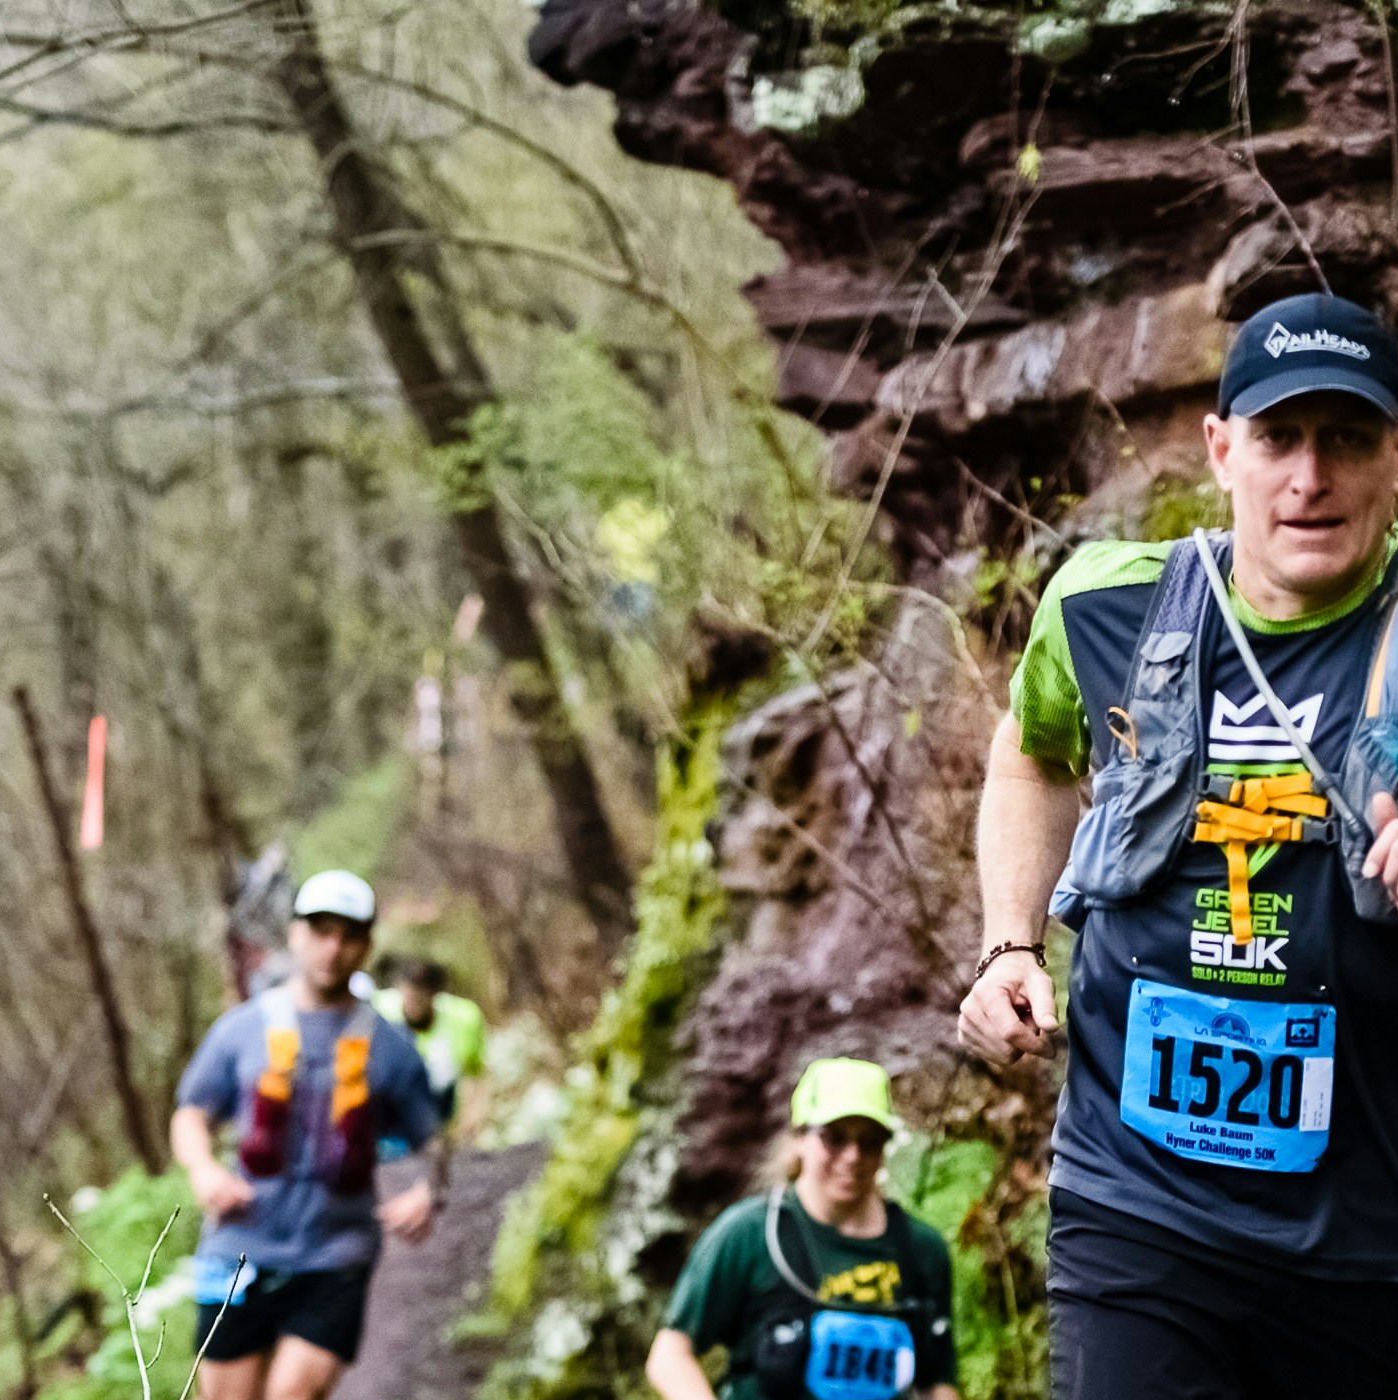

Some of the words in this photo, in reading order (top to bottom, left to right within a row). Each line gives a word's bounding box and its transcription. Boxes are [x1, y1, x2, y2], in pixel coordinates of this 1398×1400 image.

[1196, 888, 1293, 913] GREN
[1192, 911, 1289, 936] JEEL
[1190, 930, 1289, 971] 50K
[1219, 969, 1226, 982] 2
[1227, 970, 1258, 985] PERSON
[1259, 973, 1286, 986] RELAY
[1149, 1033, 1304, 1130] 1520
[1190, 1121, 1216, 1136] Luke
[1220, 1126, 1253, 1141] Baum
[1166, 1132, 1196, 1149] Hyner
[1199, 1138, 1252, 1160] Challenge
[1255, 1147, 1276, 1161] 50K
